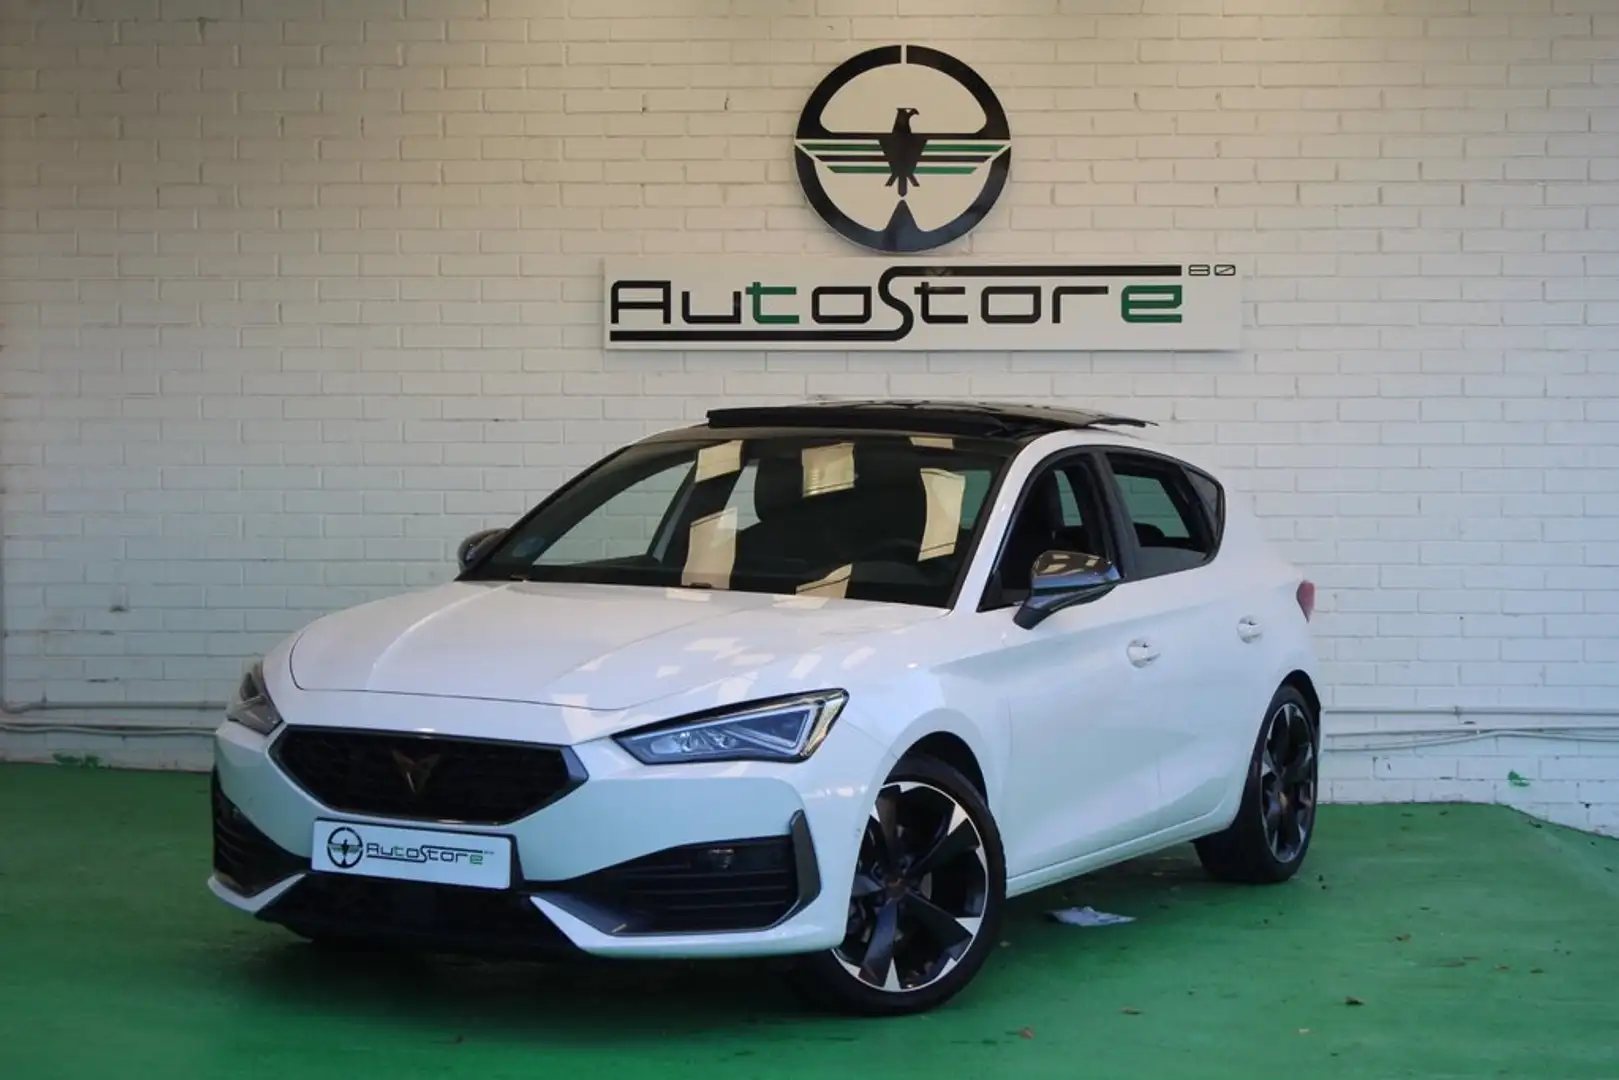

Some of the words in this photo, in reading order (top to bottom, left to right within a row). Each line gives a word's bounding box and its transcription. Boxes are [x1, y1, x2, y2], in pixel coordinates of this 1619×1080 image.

[609, 265, 1183, 341] AutoStore
[1188, 264, 1236, 276] 80
[366, 842, 483, 865] AutoStore
